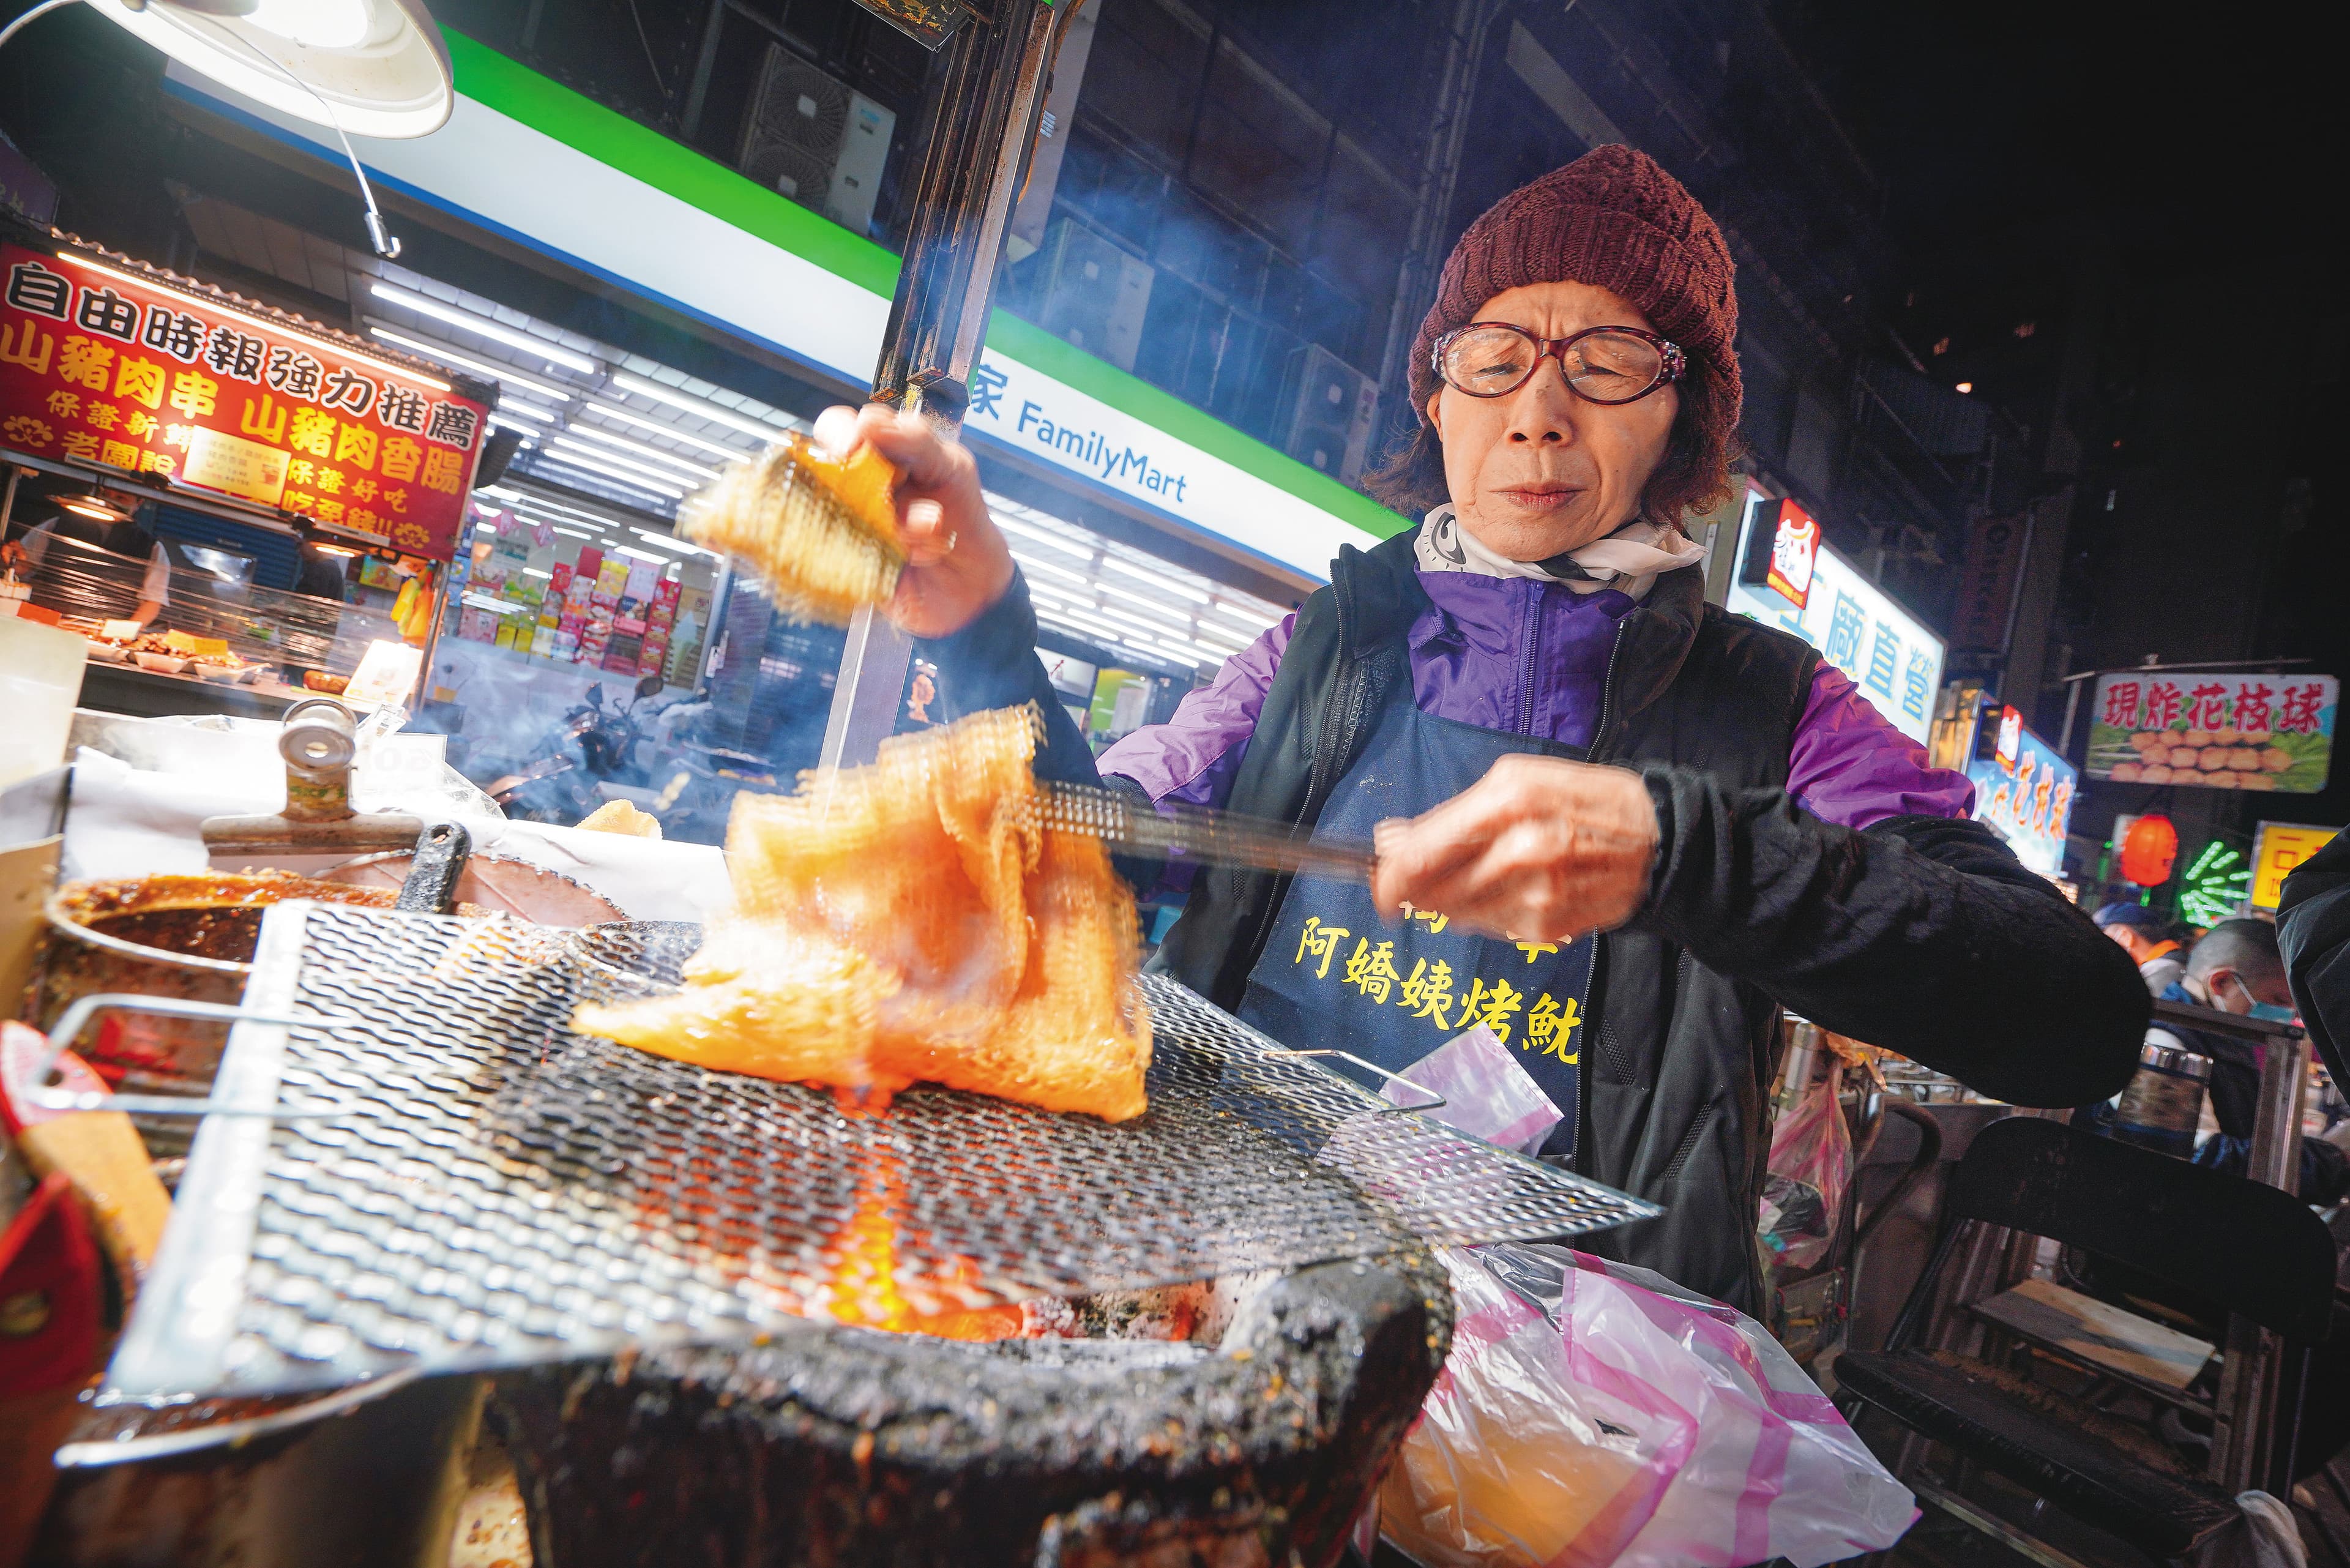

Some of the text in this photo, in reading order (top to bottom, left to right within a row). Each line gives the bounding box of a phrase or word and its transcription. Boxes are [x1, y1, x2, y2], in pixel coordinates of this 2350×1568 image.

[1, 319, 219, 420] 山豬肉串
[240, 395, 464, 496] 山豬肉香腸
[6, 262, 478, 450] 自由時報強力推薦
[288, 458, 408, 513] 保證好吃
[1018, 401, 1187, 503] FamilyMart
[2103, 682, 2324, 733] 現炸花枝球
[1295, 916, 1582, 1065] 阿嬌姨烤魷
